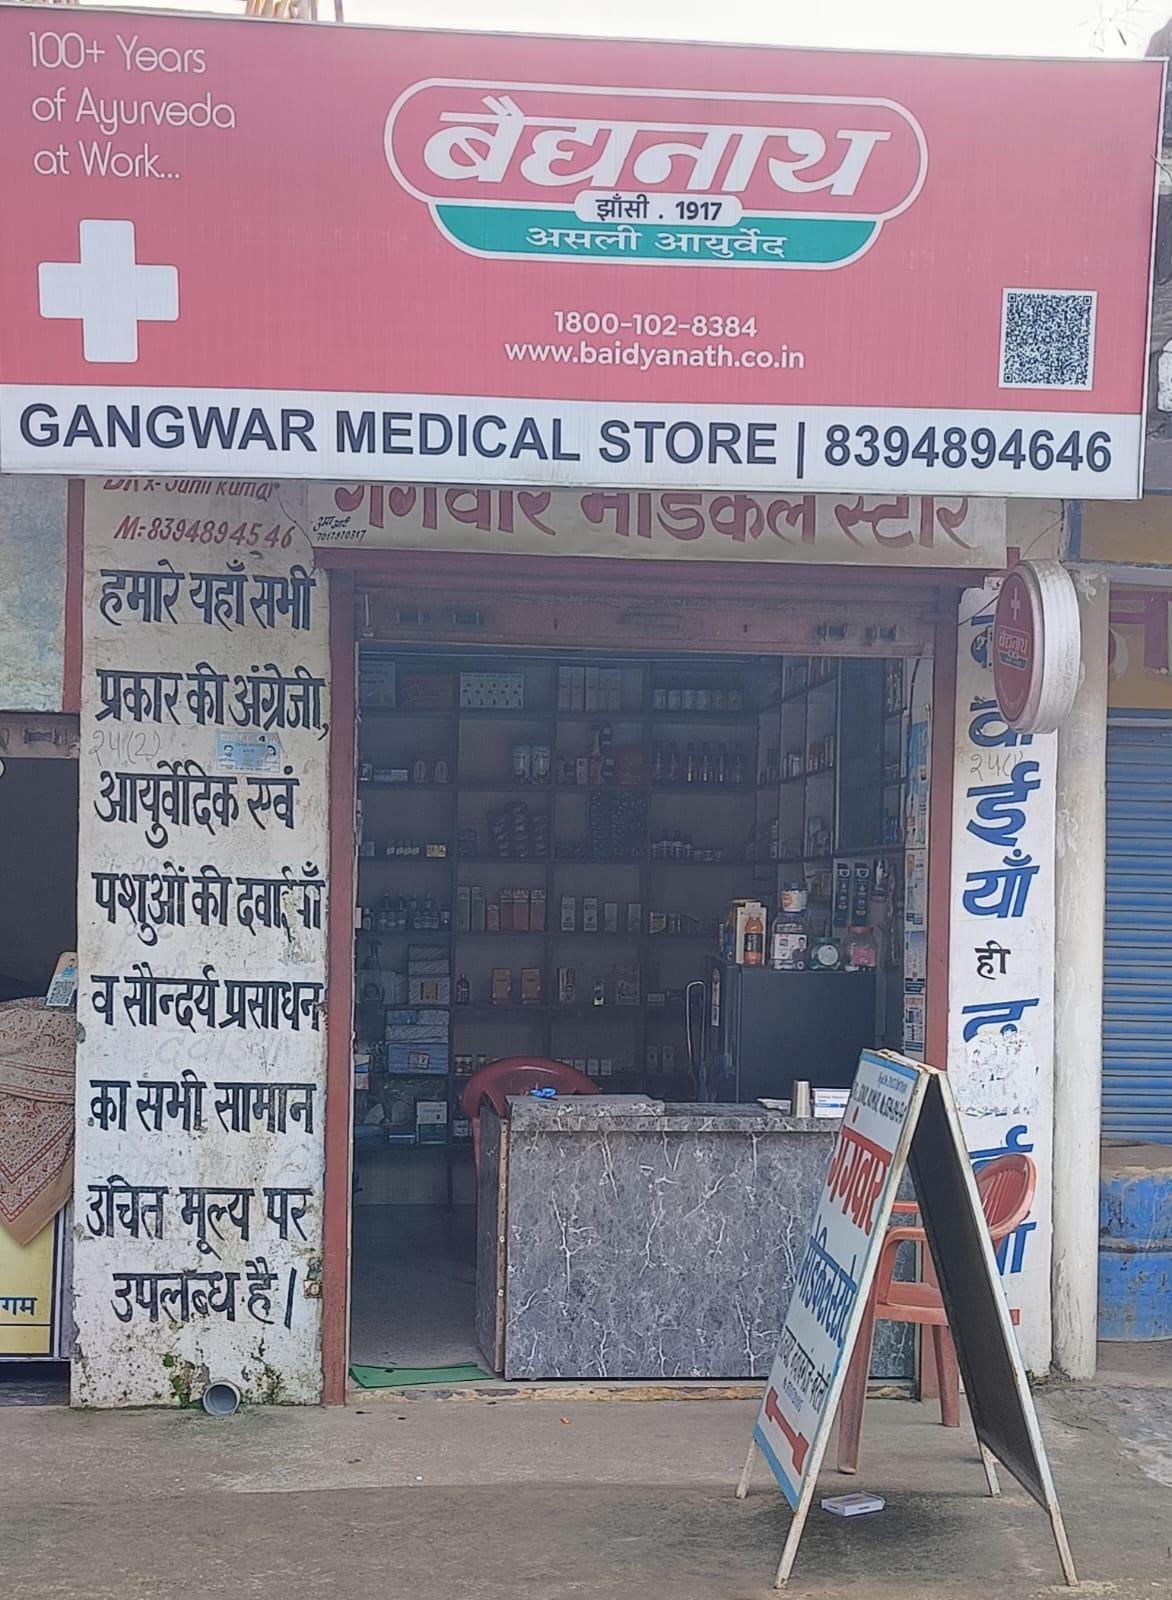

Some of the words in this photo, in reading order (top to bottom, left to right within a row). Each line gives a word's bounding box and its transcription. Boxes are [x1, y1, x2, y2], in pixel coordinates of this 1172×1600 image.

[29, 32, 105, 68] 100+
[116, 35, 206, 74] Years
[32, 87, 67, 123] of
[75, 88, 236, 135] Ayurveda
[34, 144, 69, 177] at
[77, 141, 181, 179] Work...
[424, 95, 893, 196] बैद्यनाथ
[595, 193, 650, 221] झाँसी
[675, 201, 722, 220] 1917
[526, 225, 642, 251] असली
[655, 229, 788, 258] आयुर्वेद
[554, 311, 758, 338] 1800-102-8384
[504, 340, 806, 370] www.baidyanath.co.in
[20, 404, 318, 453] GANGWAR
[336, 411, 581, 462] MEDICAL
[599, 420, 777, 466] STORE
[824, 425, 1112, 472] 8394894646
[100, 559, 185, 626] हमारे
[189, 559, 249, 631] यहाँ
[250, 565, 316, 631] सभी
[95, 669, 183, 725] प्रकार
[186, 662, 229, 727] की
[91, 861, 189, 946] पशुओं
[192, 865, 233, 927] की
[974, 941, 1011, 980] ही
[90, 975, 120, 1026] व
[124, 962, 219, 1033] सौन्दर्य
[219, 980, 324, 1031] प्रसाधन
[90, 1080, 131, 1131] का
[136, 1069, 207, 1132] सभी
[214, 1082, 317, 1134] सामान
[87, 1175, 169, 1240] उचित
[179, 1187, 255, 1260] मूल्य
[263, 1188, 314, 1241] पर
[111, 1270, 241, 1323] उपलब्ध
